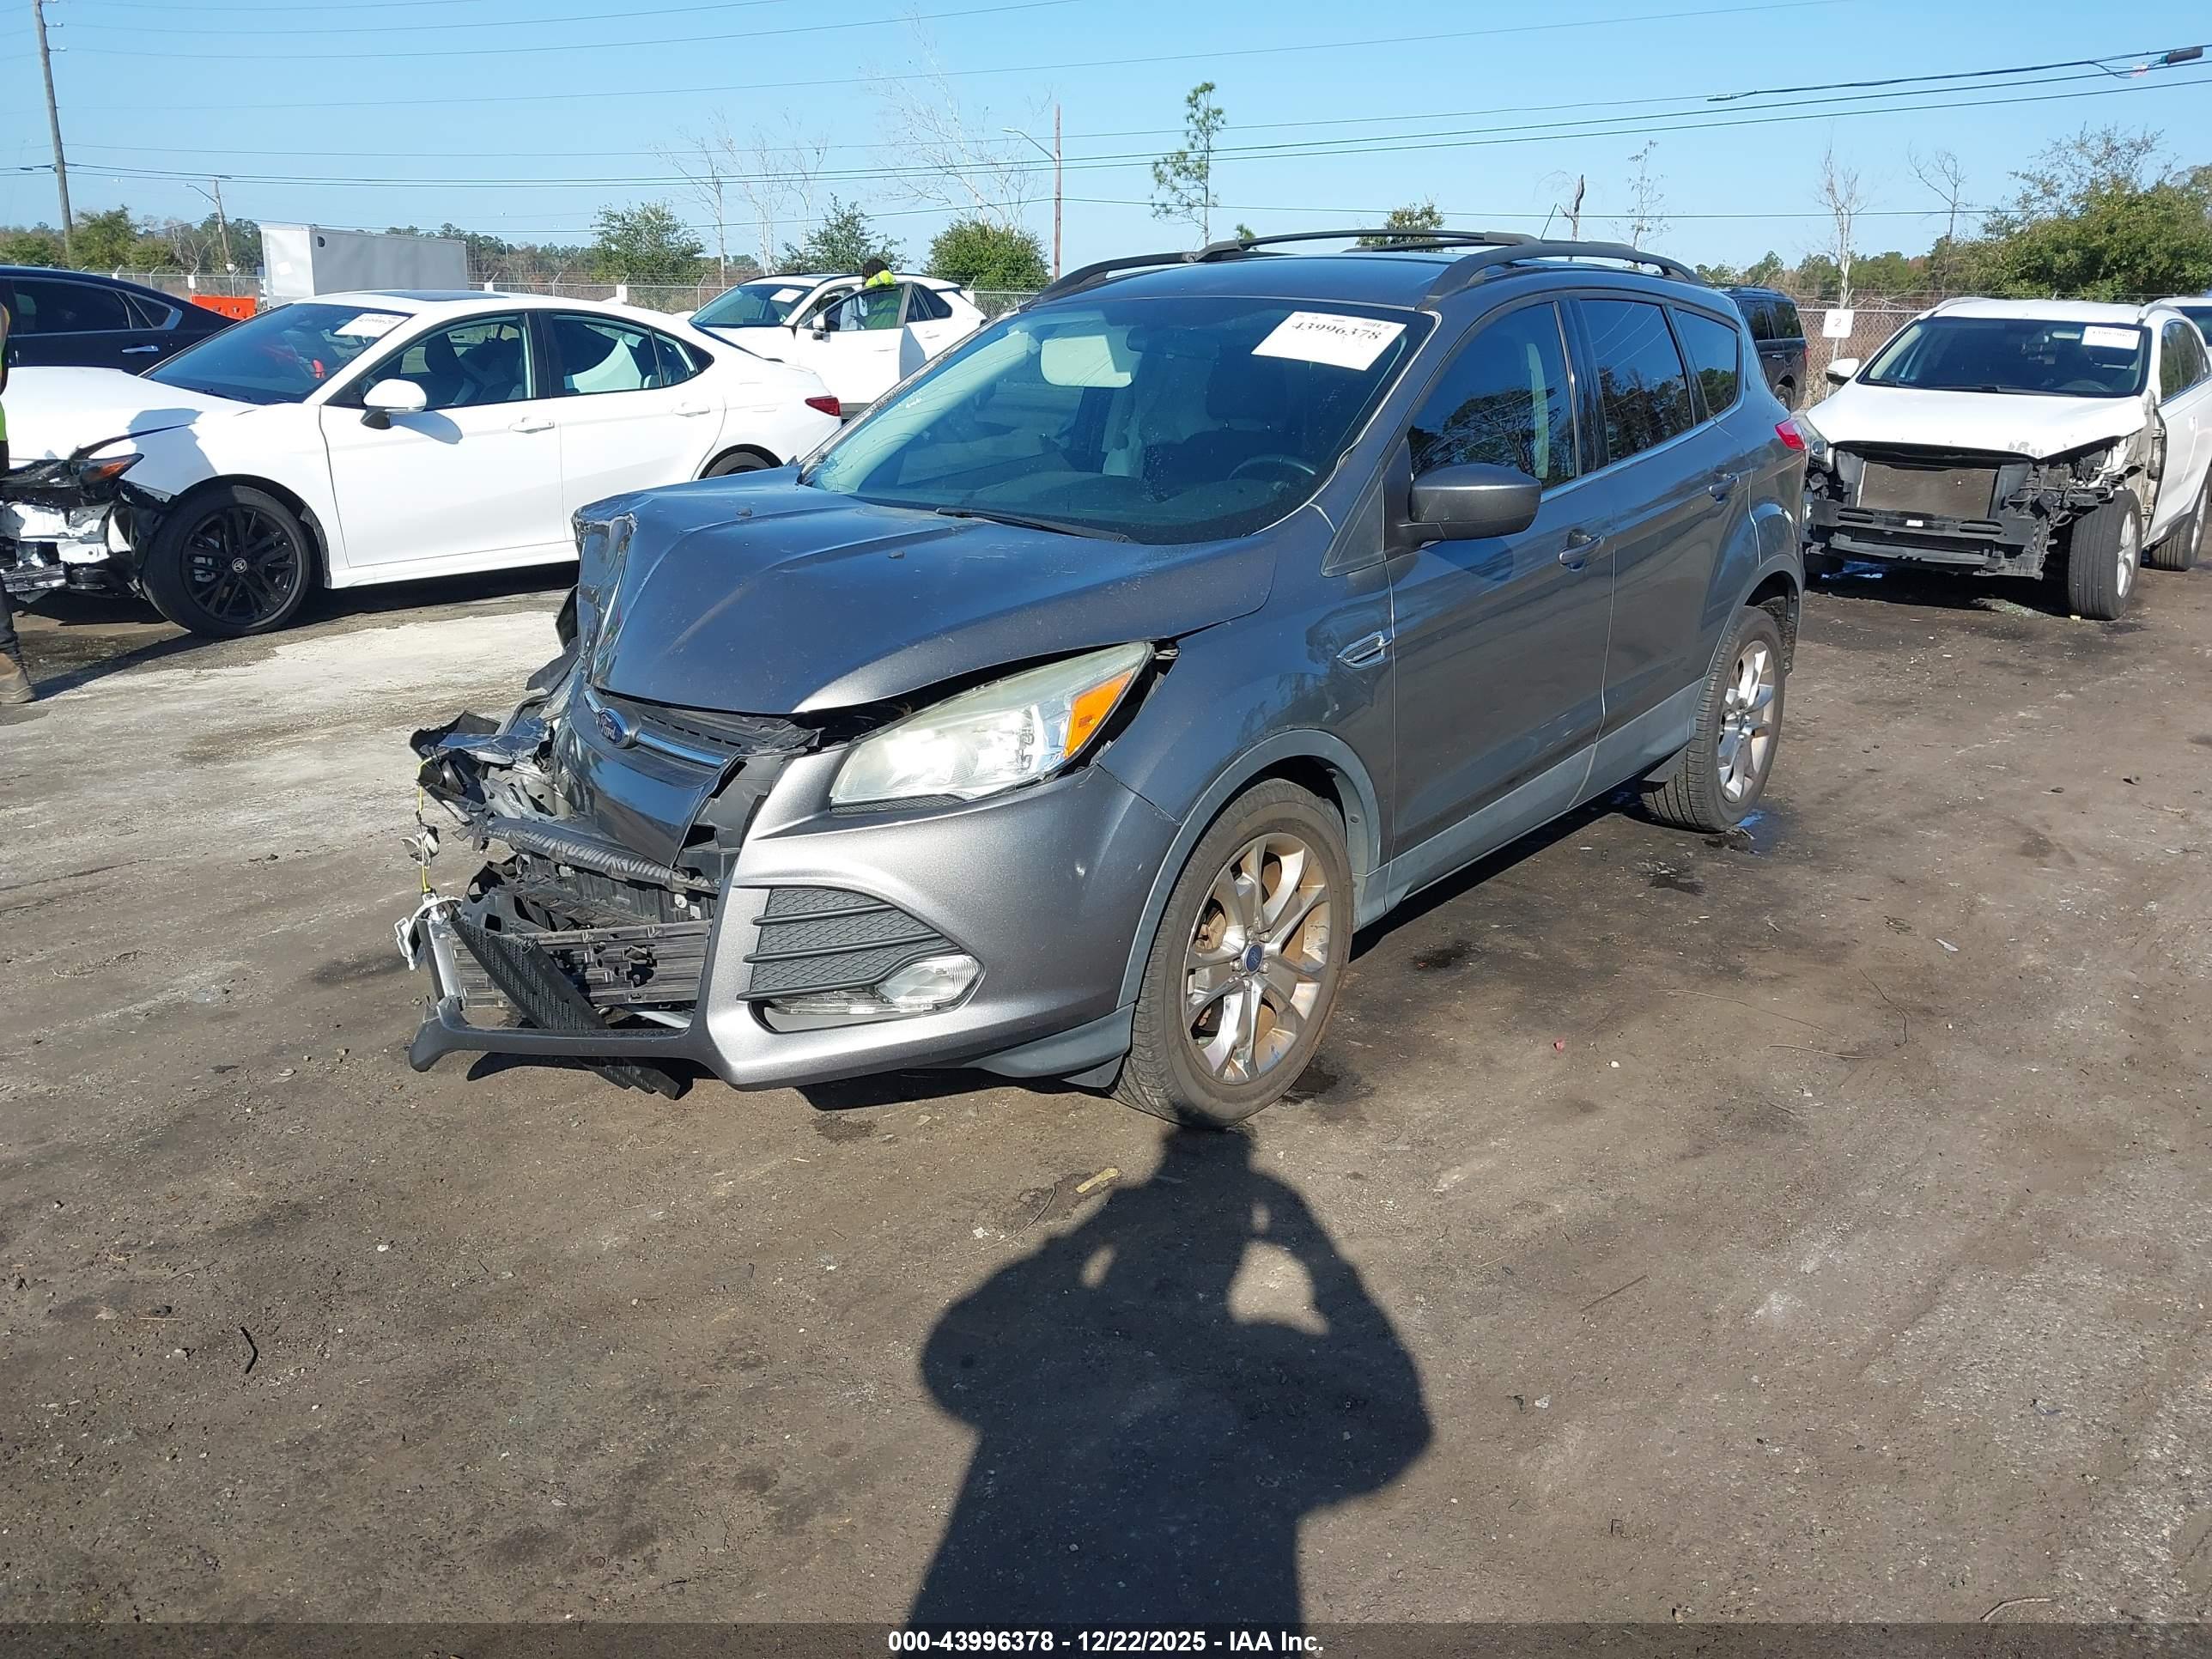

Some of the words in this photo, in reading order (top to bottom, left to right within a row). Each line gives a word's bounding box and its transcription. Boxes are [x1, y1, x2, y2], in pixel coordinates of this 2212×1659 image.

[1291, 321, 1382, 340] 43996378
[1833, 318, 1842, 328] 2
[601, 714, 617, 741] Ford
